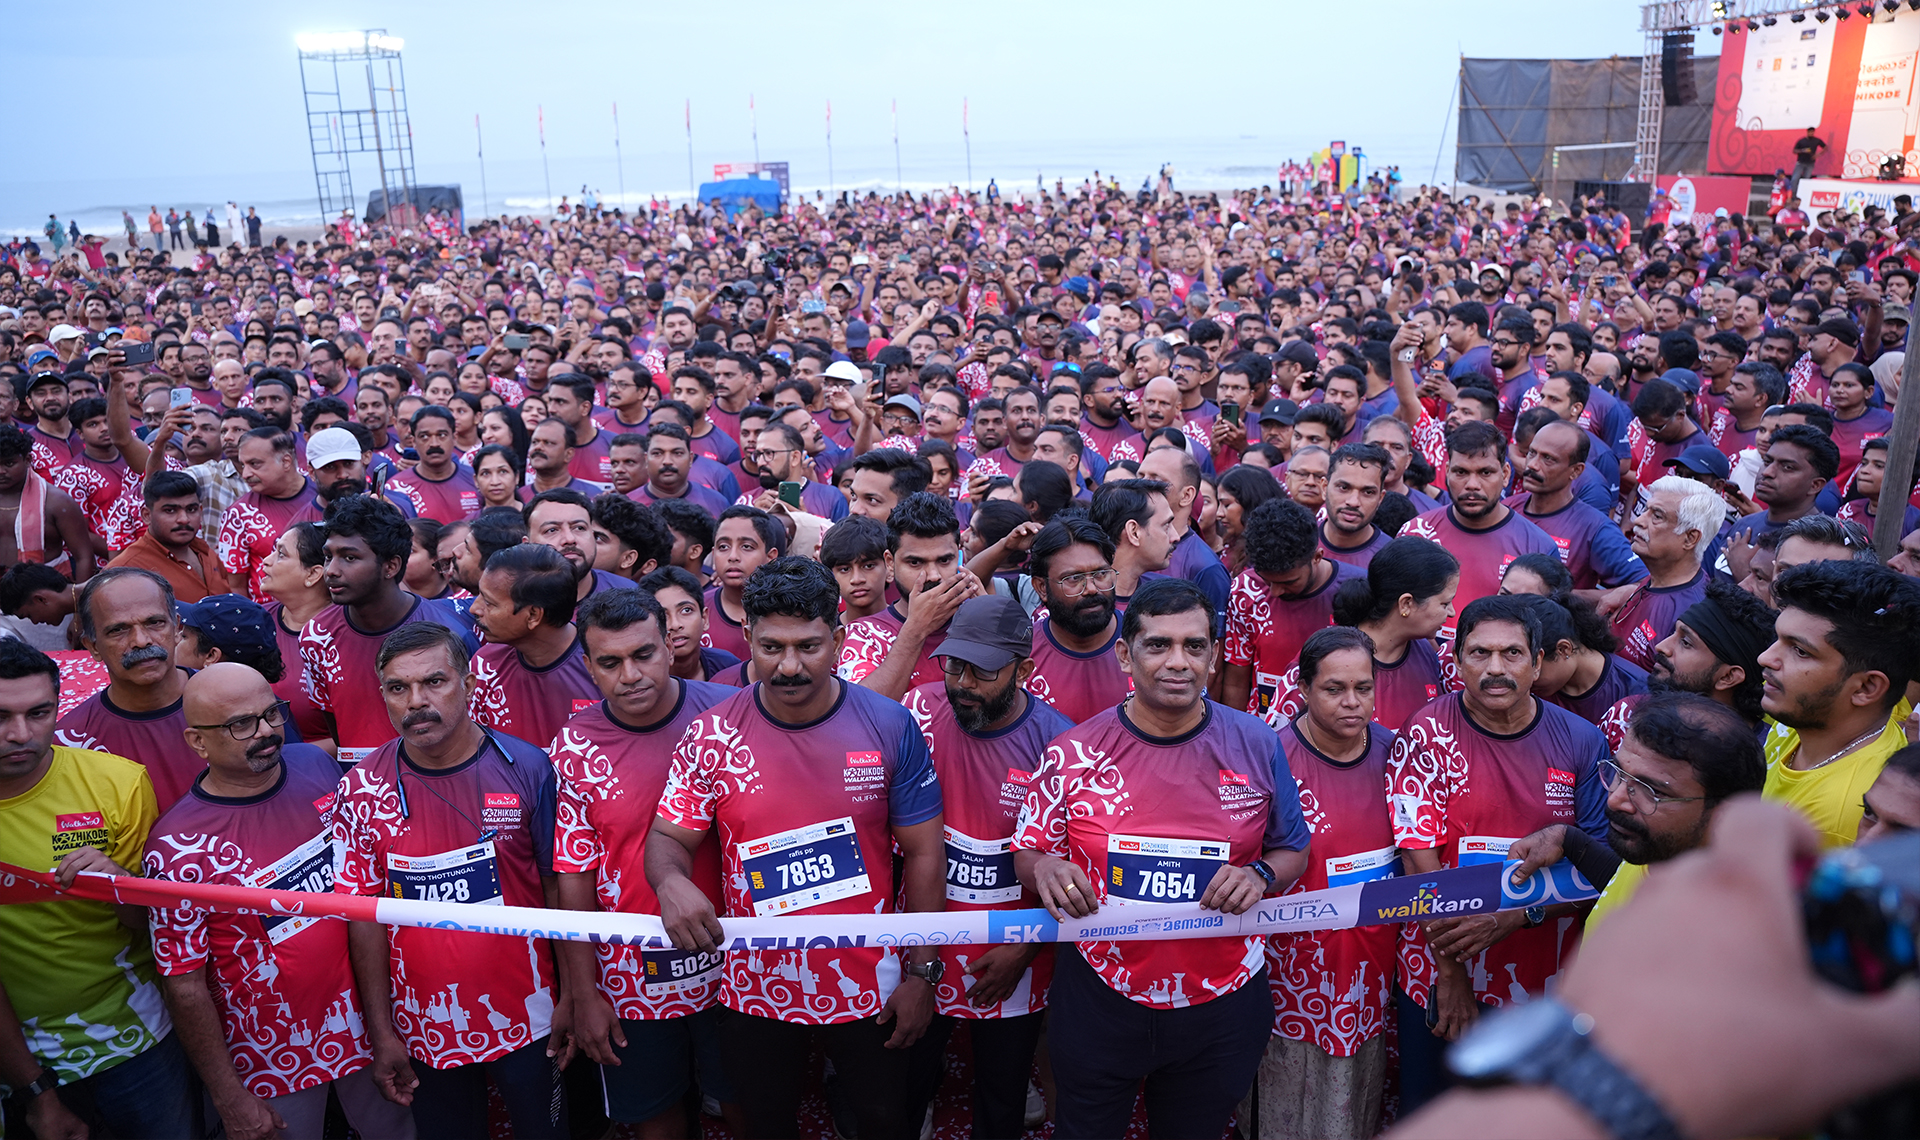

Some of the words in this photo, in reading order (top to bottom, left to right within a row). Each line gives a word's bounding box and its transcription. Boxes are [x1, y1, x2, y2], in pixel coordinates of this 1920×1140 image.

[843, 767, 884, 778] KOZHIKODE
[1001, 782, 1028, 795] KOZHI
[1001, 791, 1026, 801] WALKA
[852, 794, 878, 802] NURA
[482, 808, 522, 818] KOZHIKODE
[1230, 810, 1258, 821] NURA
[51, 829, 109, 845] KOZHIKODE
[52, 838, 109, 852] WALKATHON
[788, 850, 804, 858] rafis
[804, 847, 814, 855] pp
[962, 854, 984, 863] SALAH
[288, 871, 302, 883] Capt
[302, 857, 324, 873] Haridas
[776, 854, 836, 890] 7853
[946, 858, 998, 886] 7855
[1157, 860, 1181, 868] AMITH
[288, 863, 334, 893] 103
[428, 867, 476, 881] THOTTUNGAL
[750, 871, 765, 889] 5KM
[1112, 866, 1123, 886] 5KM
[414, 878, 470, 902] 7428
[1138, 870, 1196, 899] 7654
[1257, 903, 1339, 923] NURA
[1378, 898, 1484, 919] walkkaro
[1002, 924, 1043, 944] 5K
